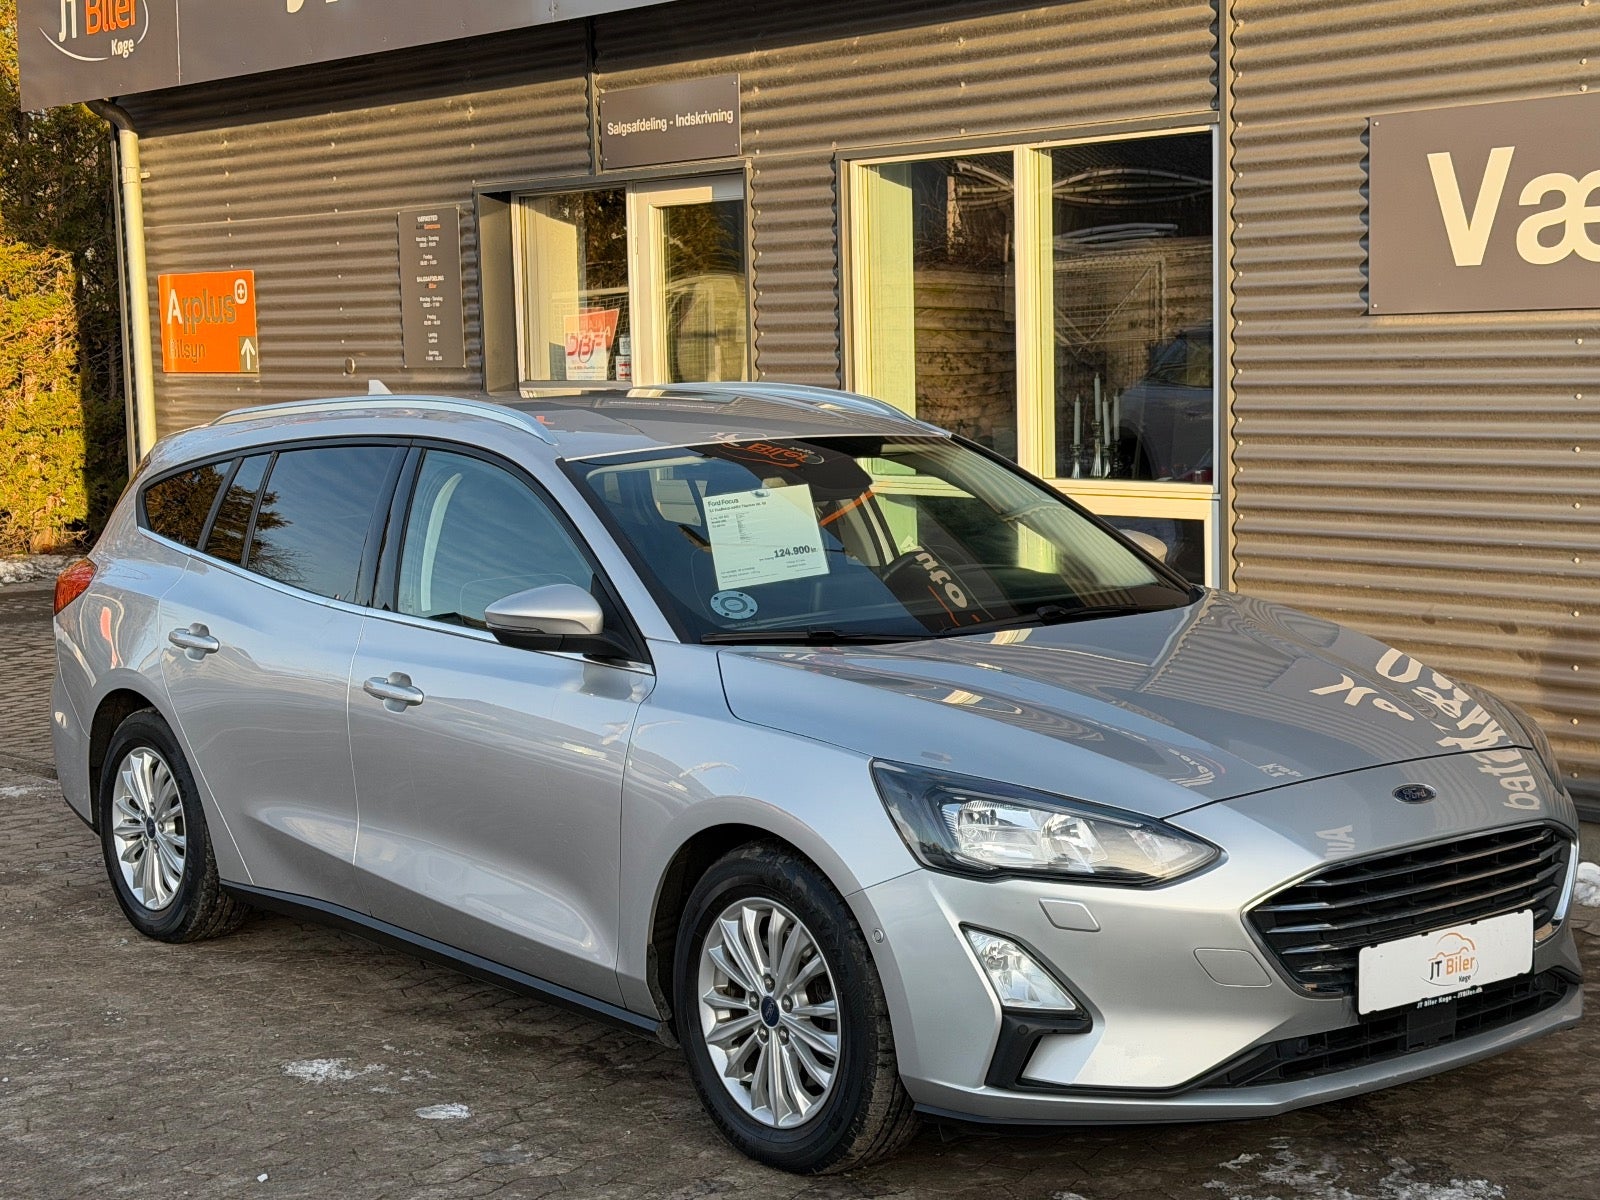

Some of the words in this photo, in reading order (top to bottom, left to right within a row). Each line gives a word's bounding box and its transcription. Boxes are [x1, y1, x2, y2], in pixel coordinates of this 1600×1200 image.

[111, 38, 134, 59] Køge
[607, 116, 667, 137] Salgsafdeling
[675, 109, 733, 127] Indskrivning
[1429, 960, 1443, 980] JT
[1446, 955, 1475, 975] Biler
[1416, 1001, 1423, 1009] JT
